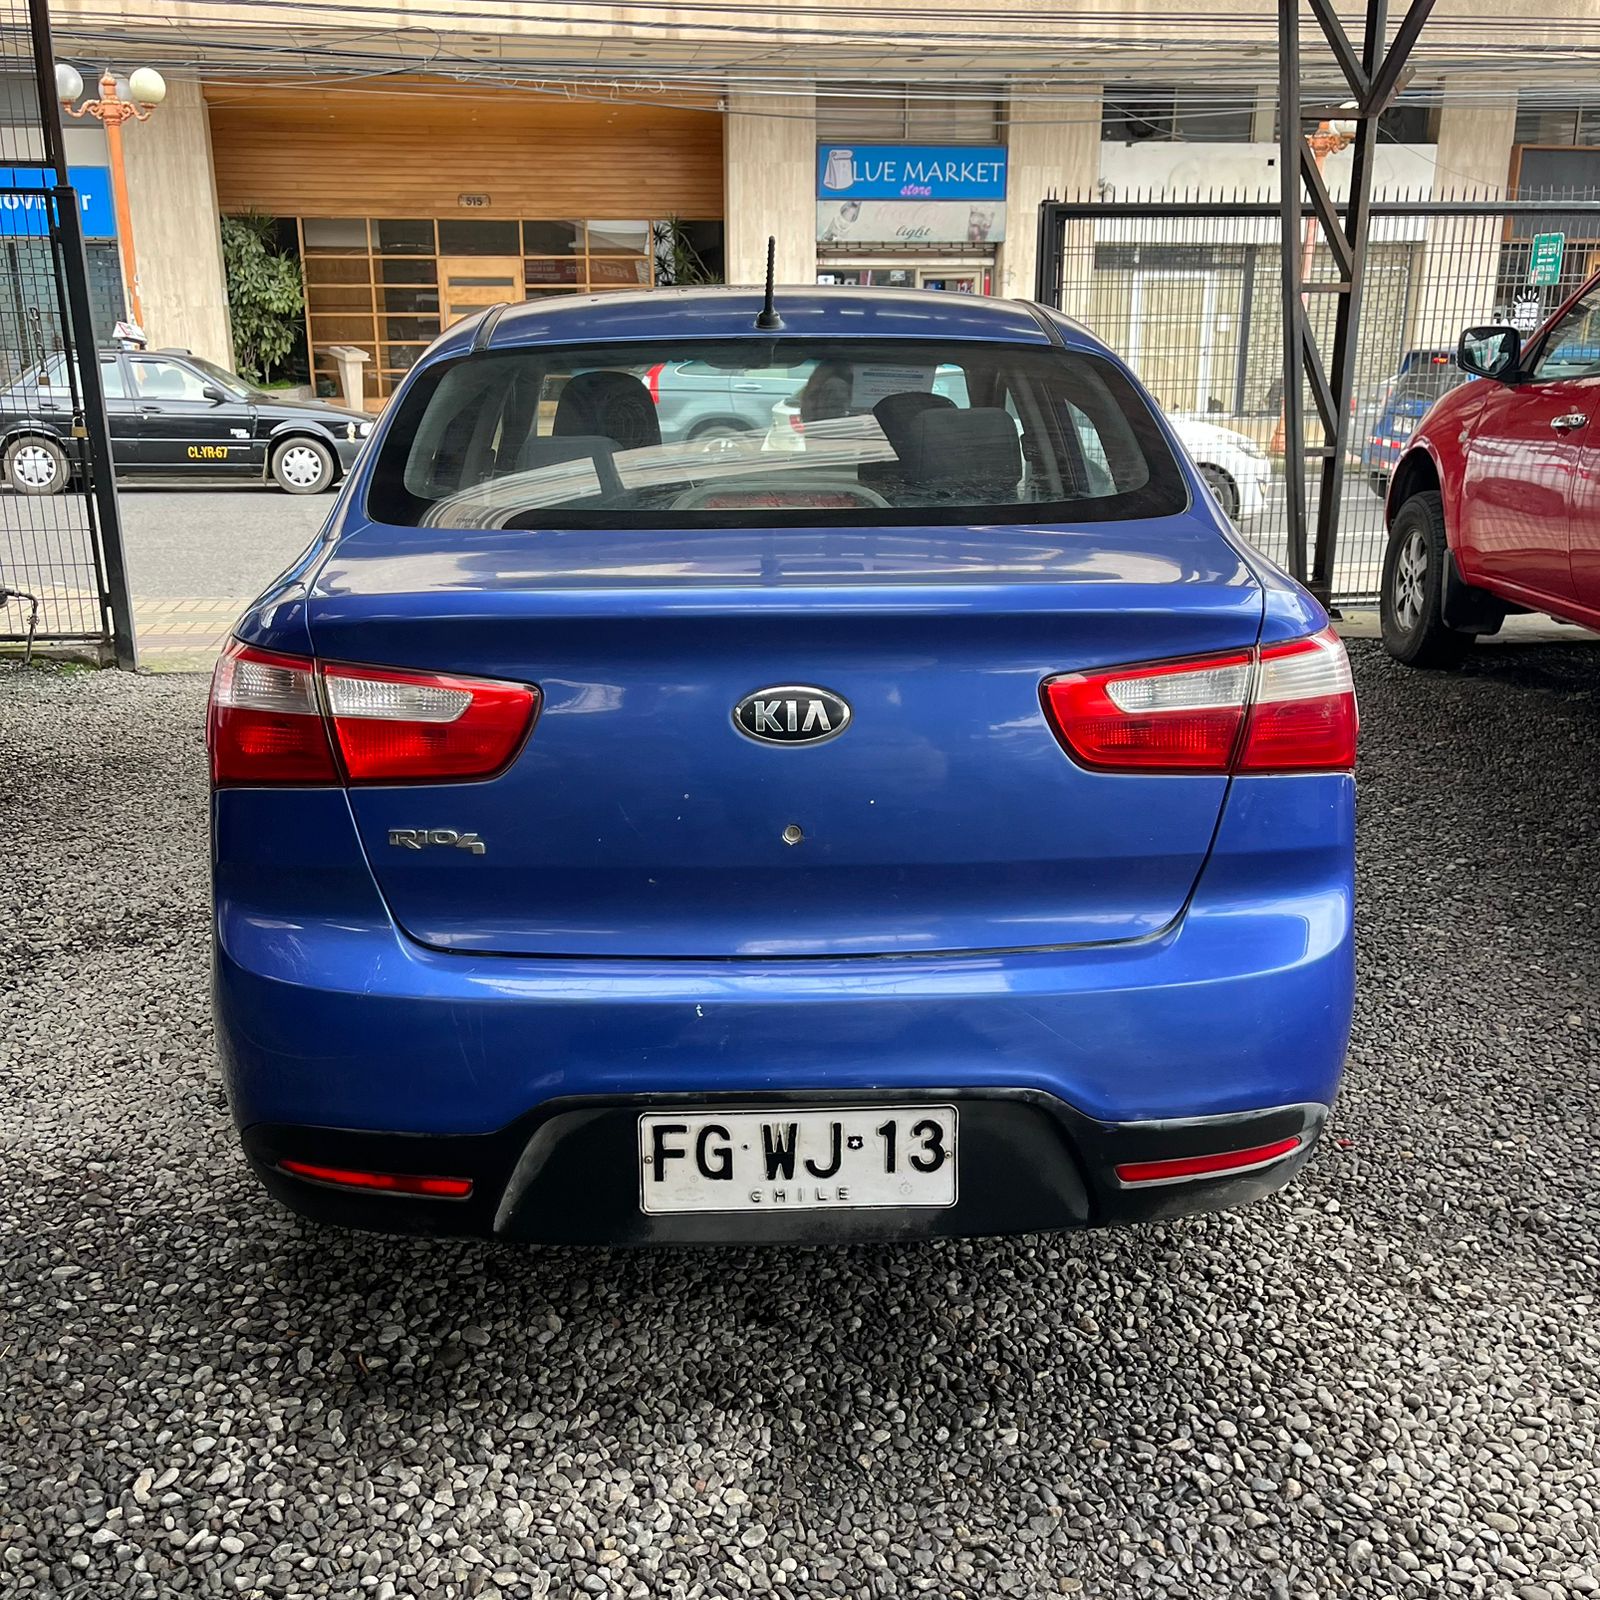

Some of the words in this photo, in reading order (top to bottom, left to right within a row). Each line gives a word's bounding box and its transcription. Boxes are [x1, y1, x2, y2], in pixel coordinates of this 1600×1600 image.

[902, 161, 1005, 183] MARKET
[900, 183, 933, 197] store
[466, 197, 483, 206] 515
[895, 225, 932, 240] light
[753, 699, 832, 733] KIA
[750, 1186, 851, 1203] CHILE
